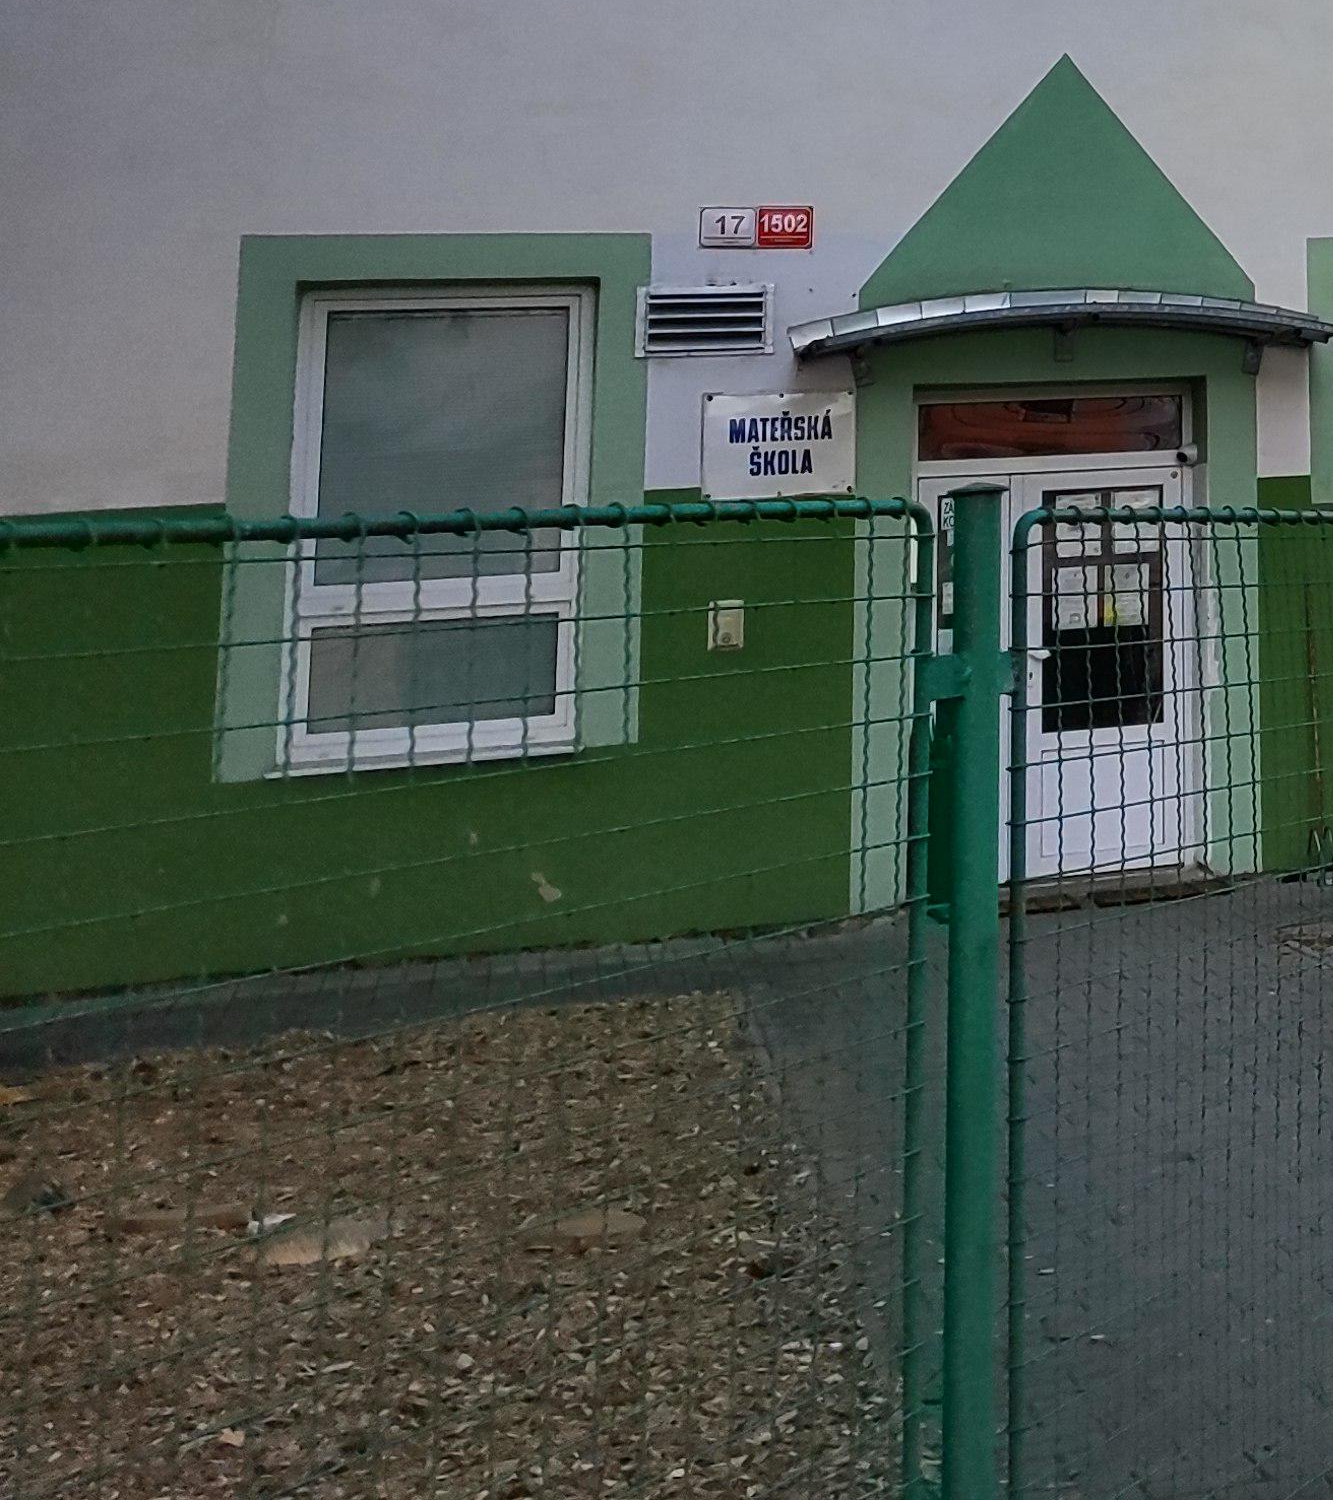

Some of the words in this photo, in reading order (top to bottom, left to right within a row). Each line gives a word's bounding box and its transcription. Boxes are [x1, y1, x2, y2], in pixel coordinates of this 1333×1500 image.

[714, 215, 745, 234] 17
[759, 213, 808, 233] 1502
[729, 408, 833, 444] MATEŘSKÁ
[749, 445, 813, 476] ŠKOLA
